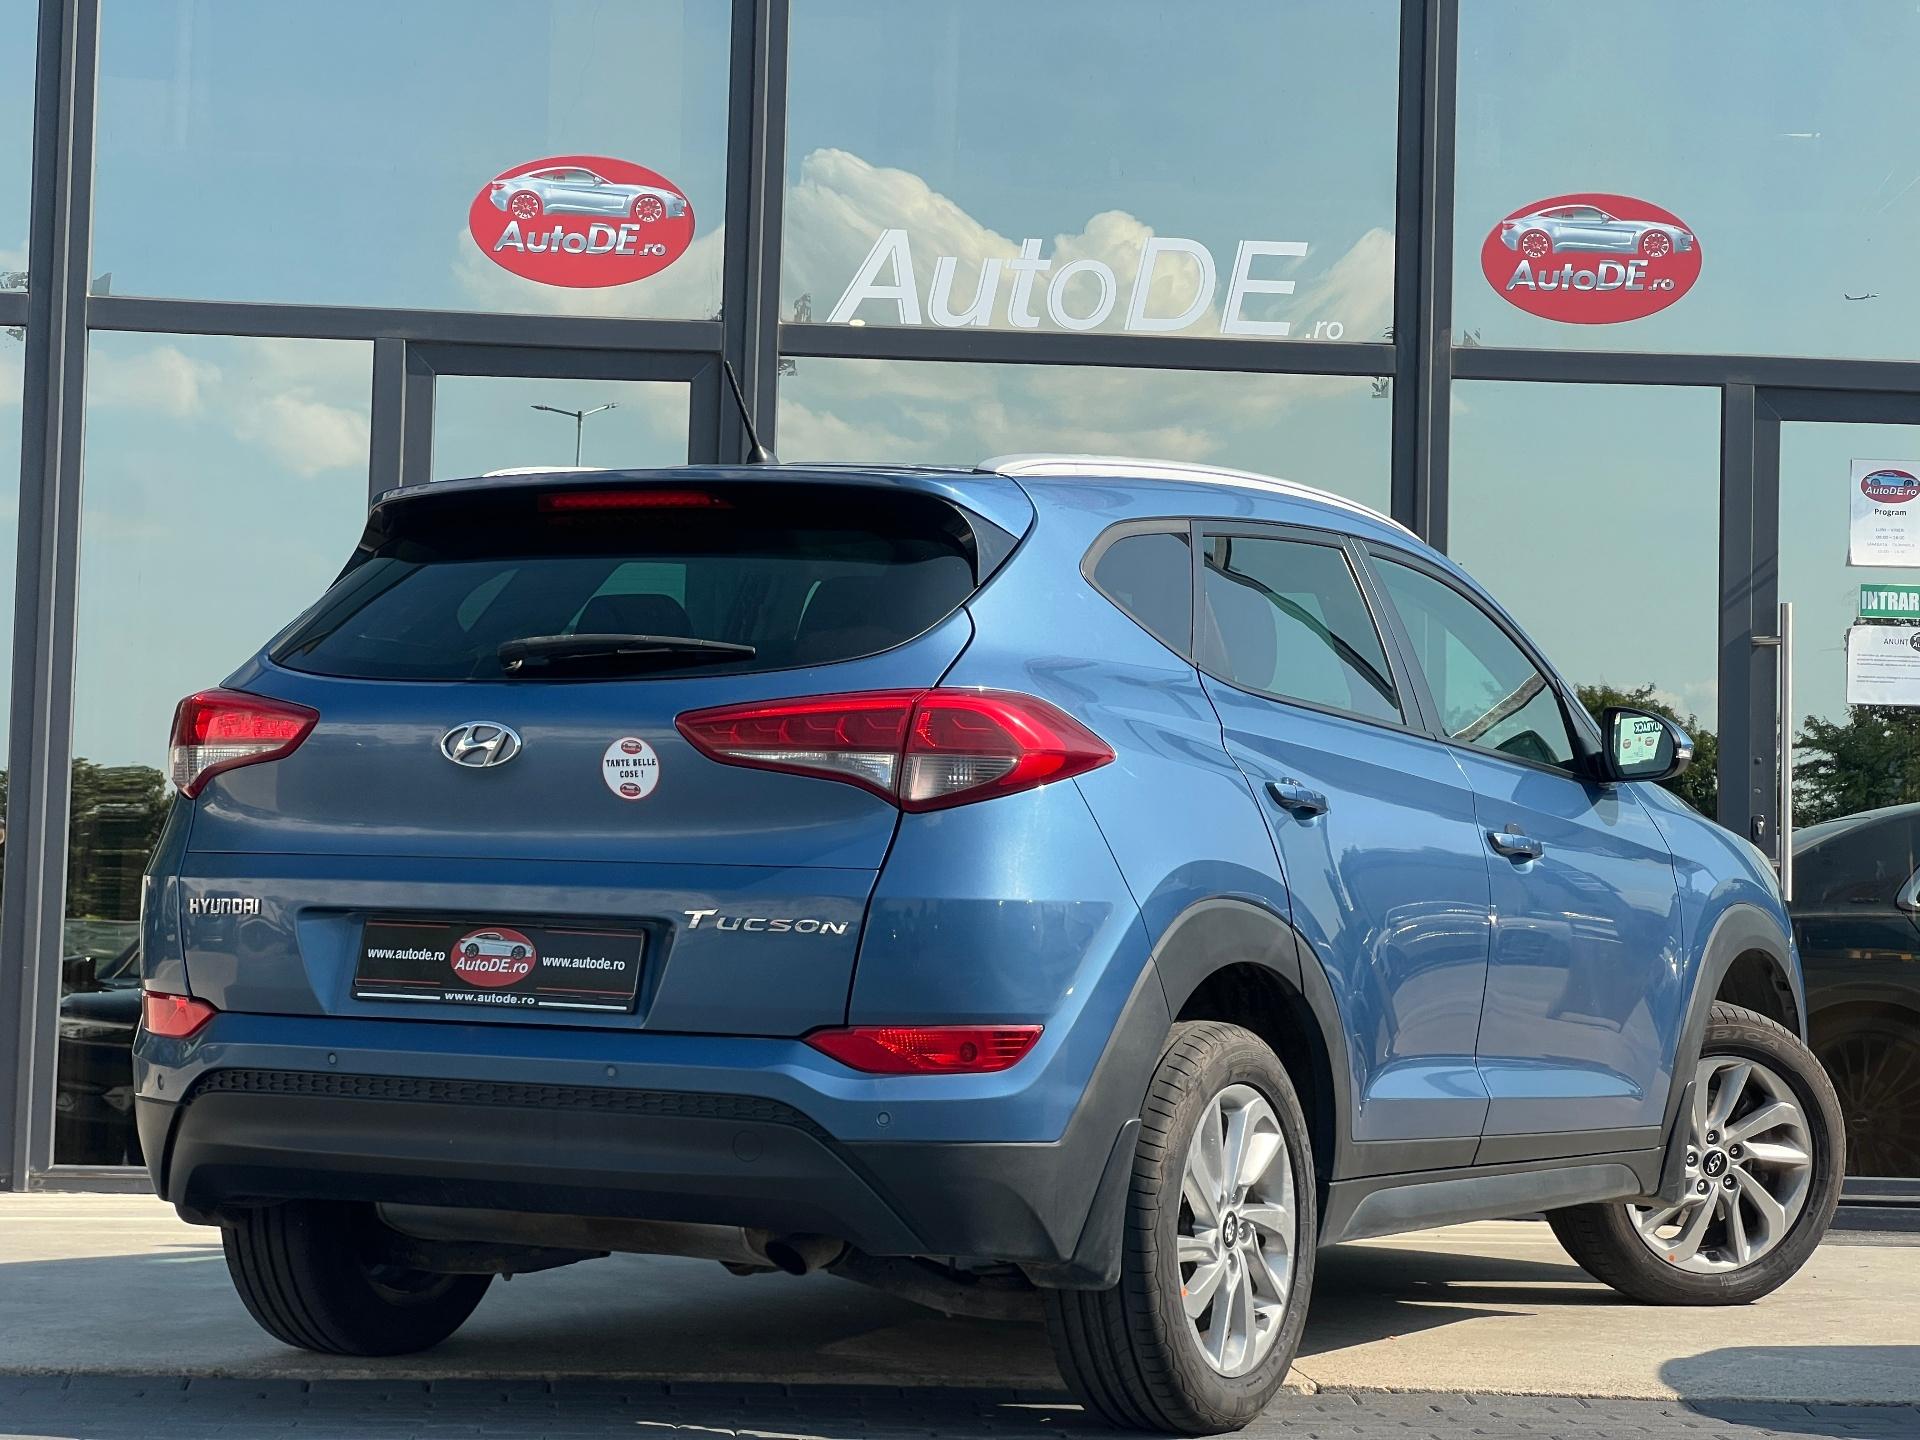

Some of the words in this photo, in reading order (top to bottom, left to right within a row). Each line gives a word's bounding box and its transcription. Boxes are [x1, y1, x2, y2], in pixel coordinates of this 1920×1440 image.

[1865, 486, 1917, 496] AutoDE.ro
[1874, 508, 1907, 517] Program
[606, 759, 630, 767] TANTE
[632, 758, 656, 766] BELLE
[619, 770, 639, 778] COSE
[189, 898, 262, 915] HYUNDAI
[367, 947, 446, 962] www.autode.ro
[454, 956, 529, 974] AutoDE.ro
[542, 955, 626, 971] www.autode.ro
[444, 991, 535, 1005] www.autode.ro
[1706, 1029, 1779, 1052] BICA
